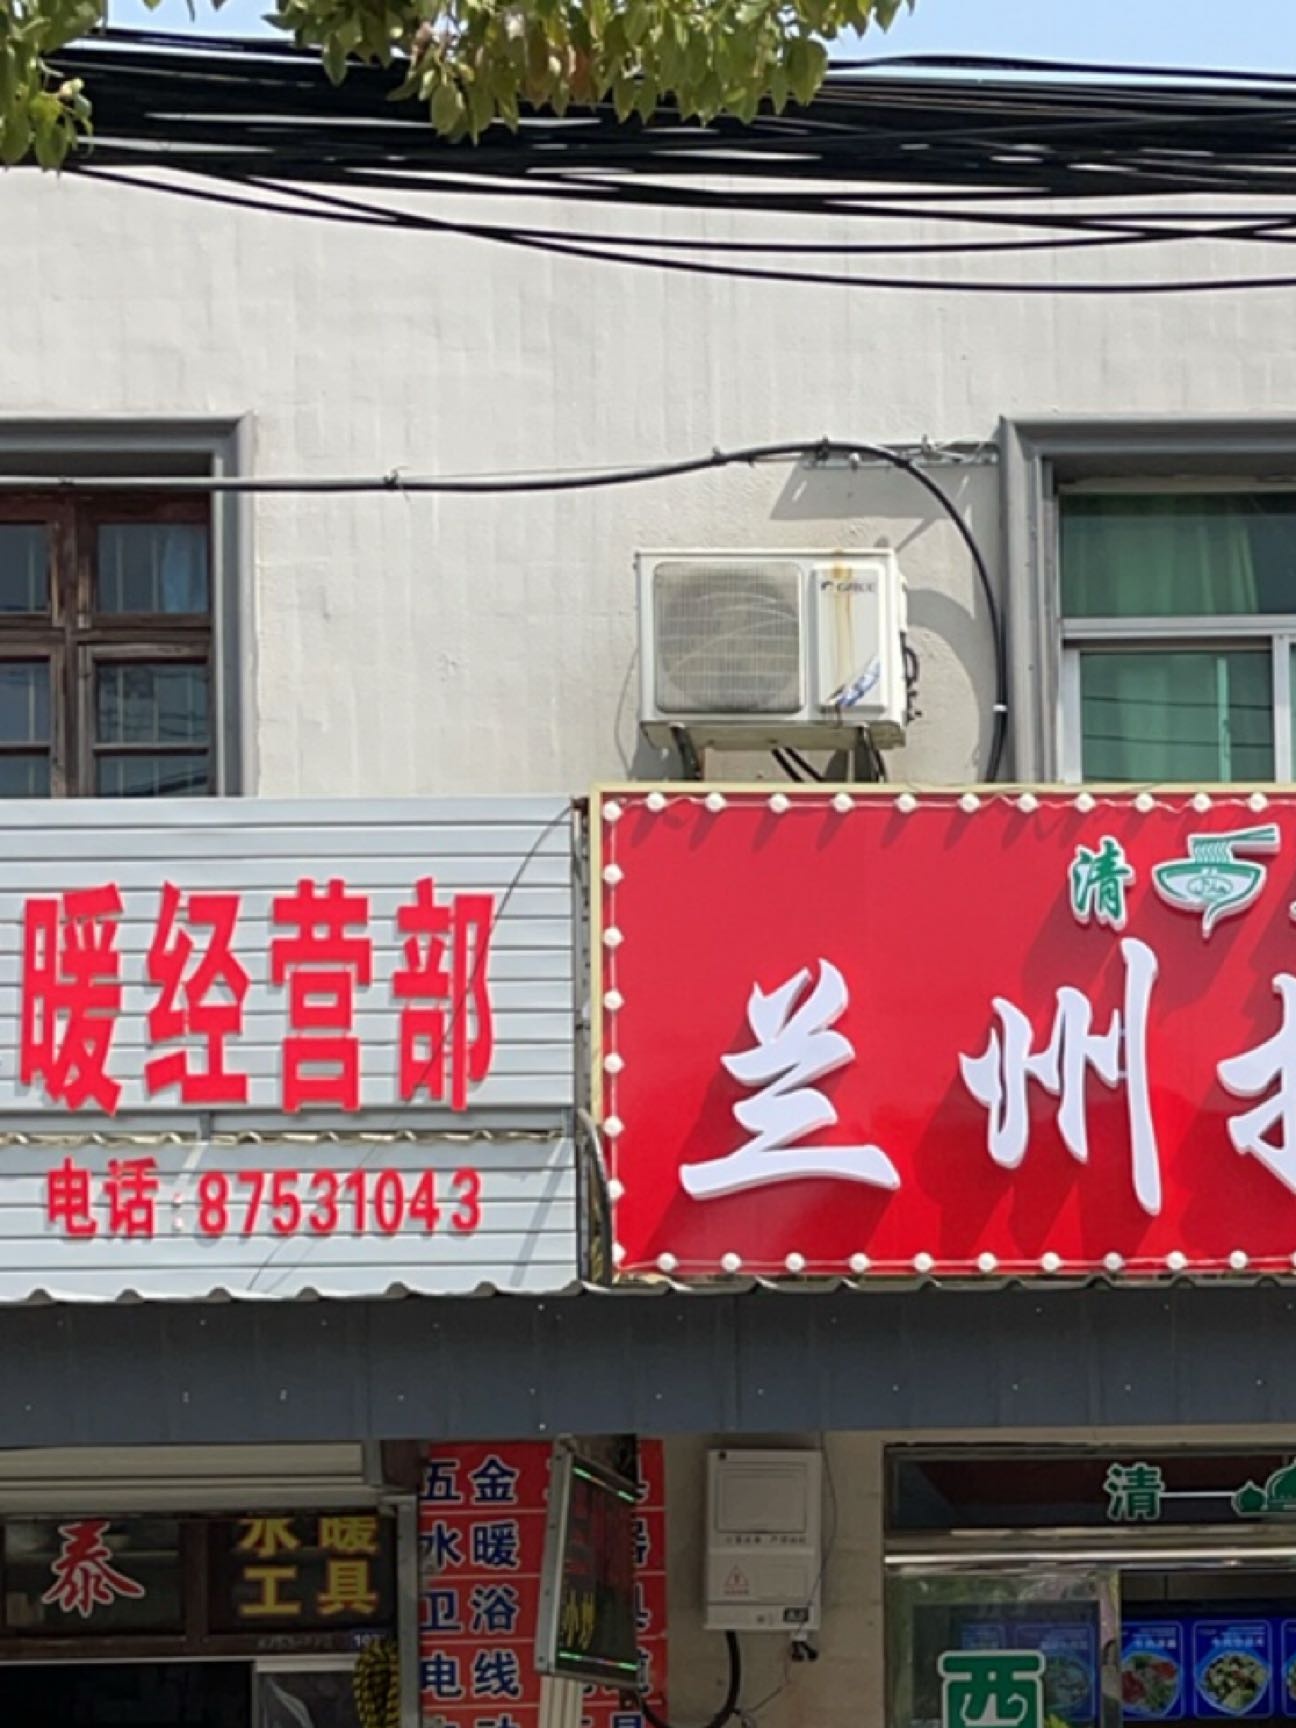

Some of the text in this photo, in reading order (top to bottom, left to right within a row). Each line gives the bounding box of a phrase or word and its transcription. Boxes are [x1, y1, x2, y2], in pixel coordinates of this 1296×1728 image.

[1070, 838, 1133, 927] 清
[20, 877, 495, 1116] 暖经营部
[1103, 1462, 1162, 1521] 清
[41, 1519, 146, 1619] 泰
[238, 1559, 379, 1617] 工具
